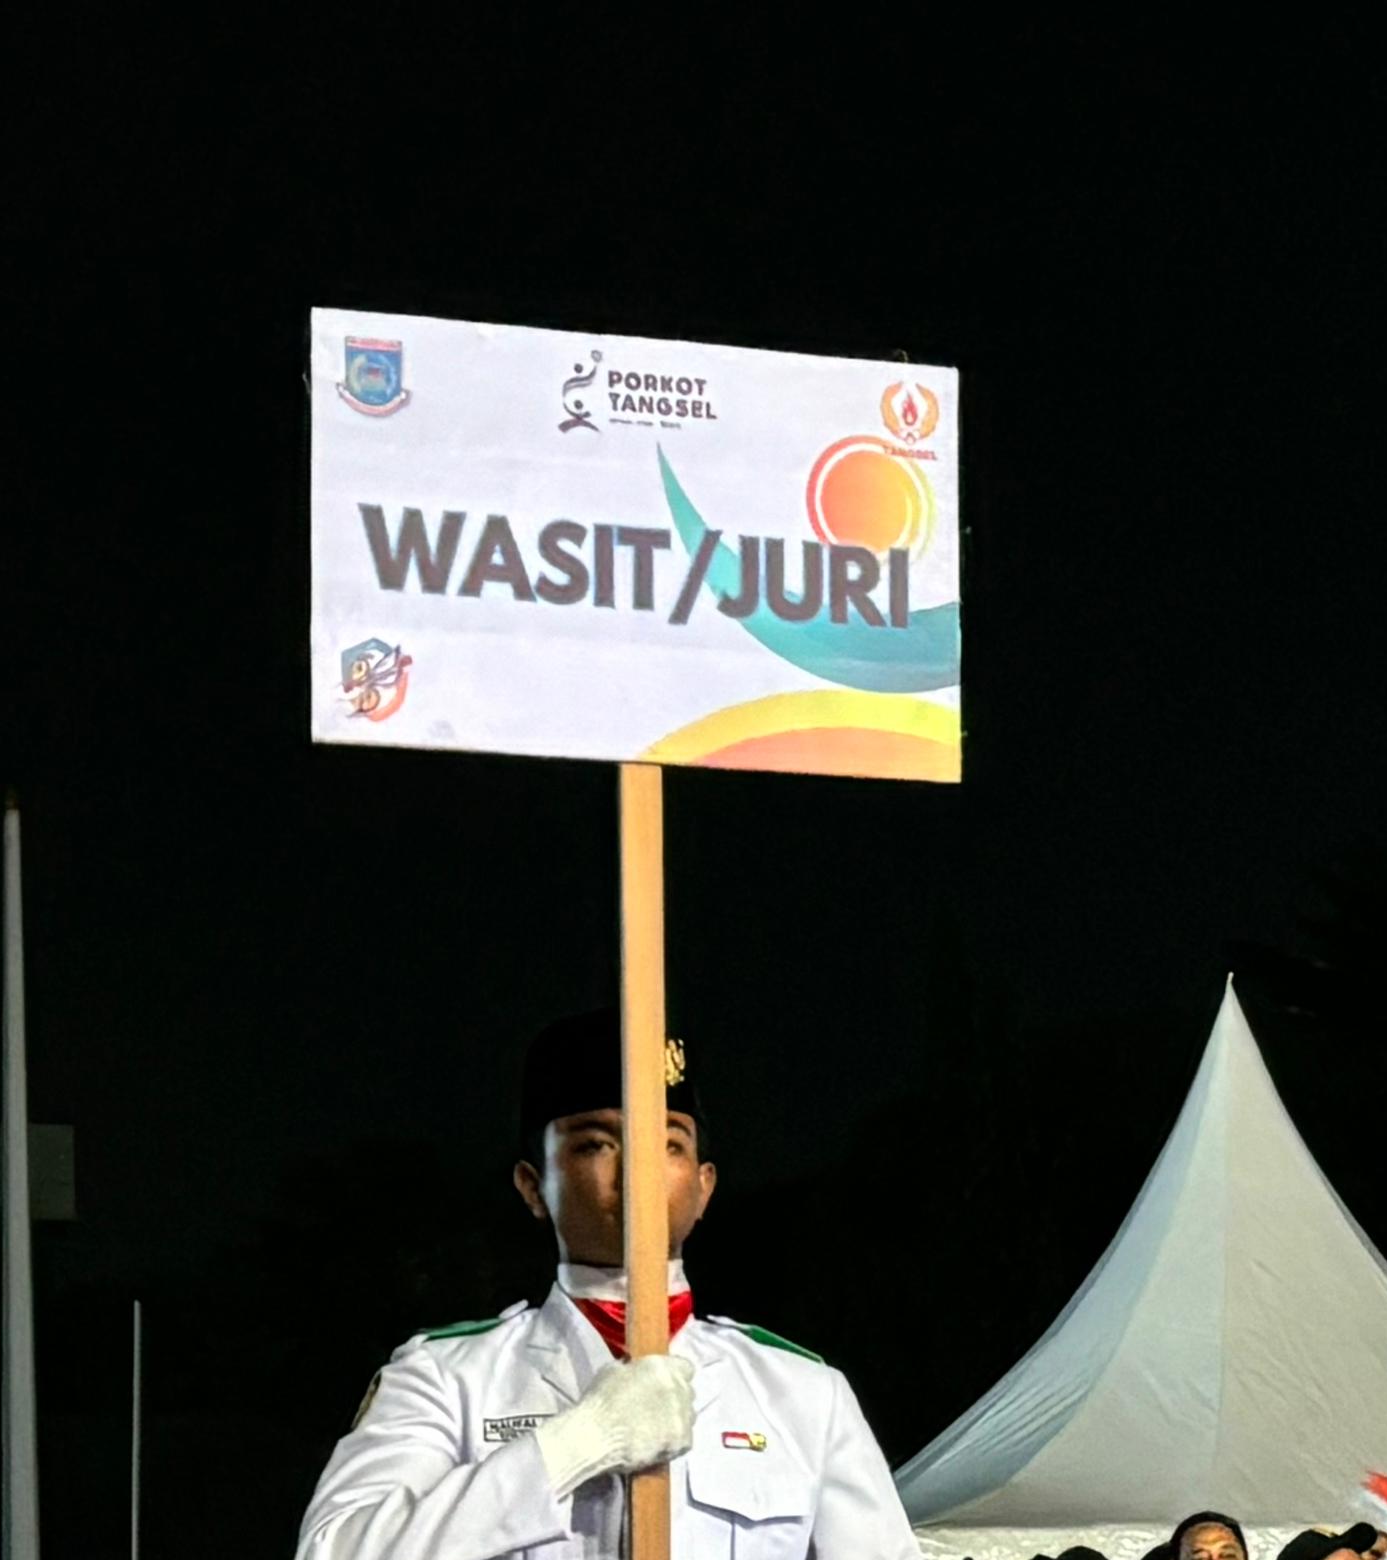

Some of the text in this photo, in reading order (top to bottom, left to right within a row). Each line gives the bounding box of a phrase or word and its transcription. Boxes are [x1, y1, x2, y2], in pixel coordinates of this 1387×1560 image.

[608, 370, 707, 396] PORKOT
[608, 392, 718, 420] TANGSEL
[358, 502, 909, 629] WASIT/JURI
